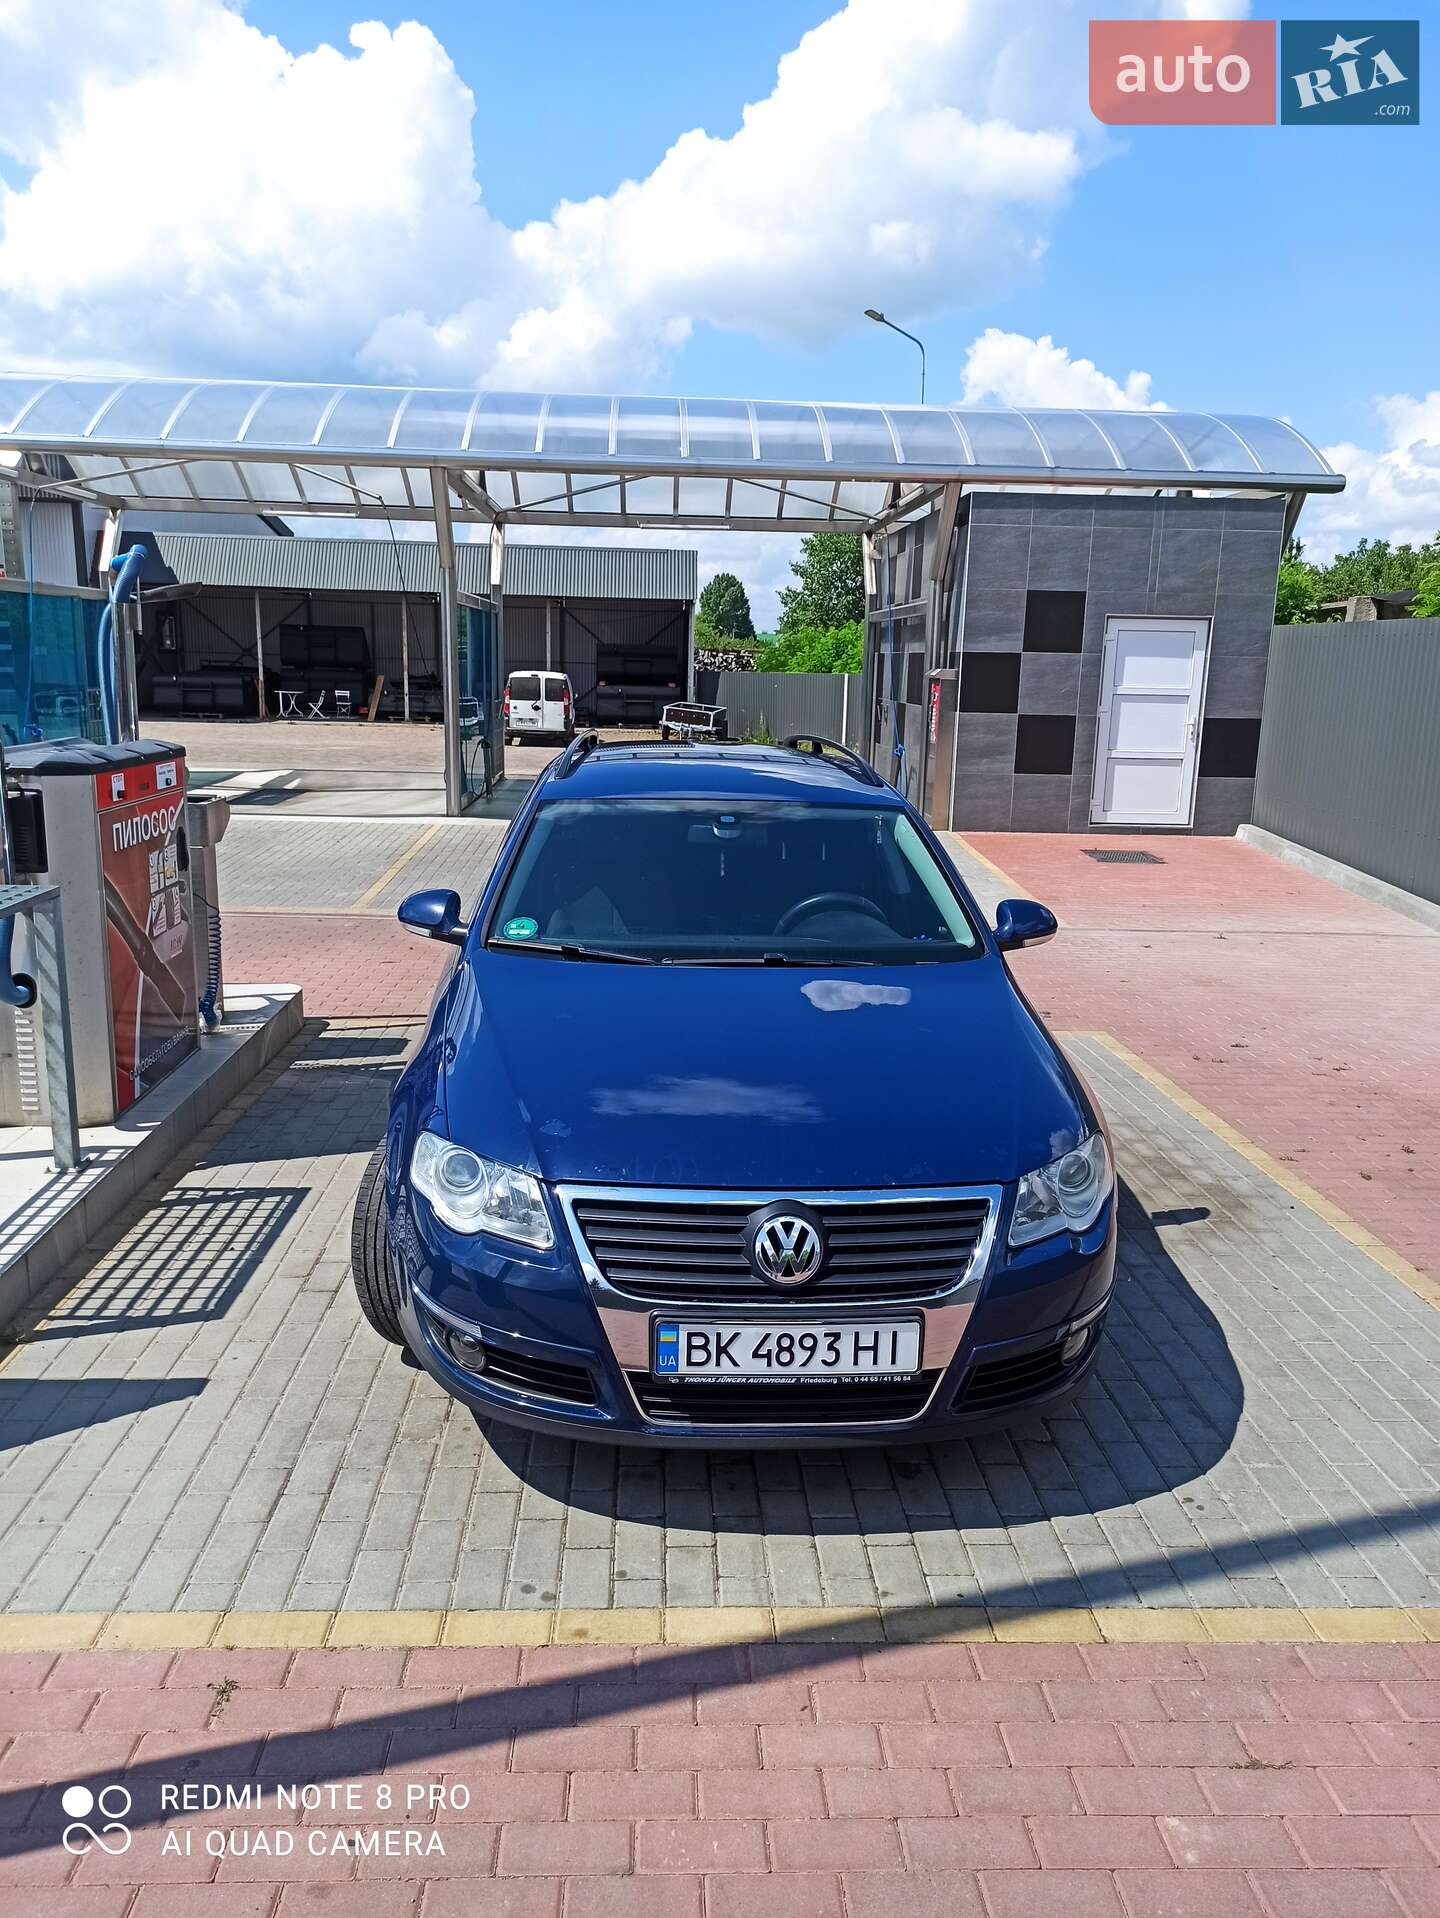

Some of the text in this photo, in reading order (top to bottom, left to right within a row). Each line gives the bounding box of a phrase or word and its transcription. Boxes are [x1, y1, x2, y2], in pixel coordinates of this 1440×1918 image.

[112, 805, 177, 852] ПИЛОСОС
[686, 1330, 898, 1368] BK 4893 HI
[659, 1356, 677, 1367] UA
[683, 1376, 716, 1384] THOMAS
[715, 1375, 747, 1384] JÜNGER
[800, 1376, 838, 1384] Friedeburg
